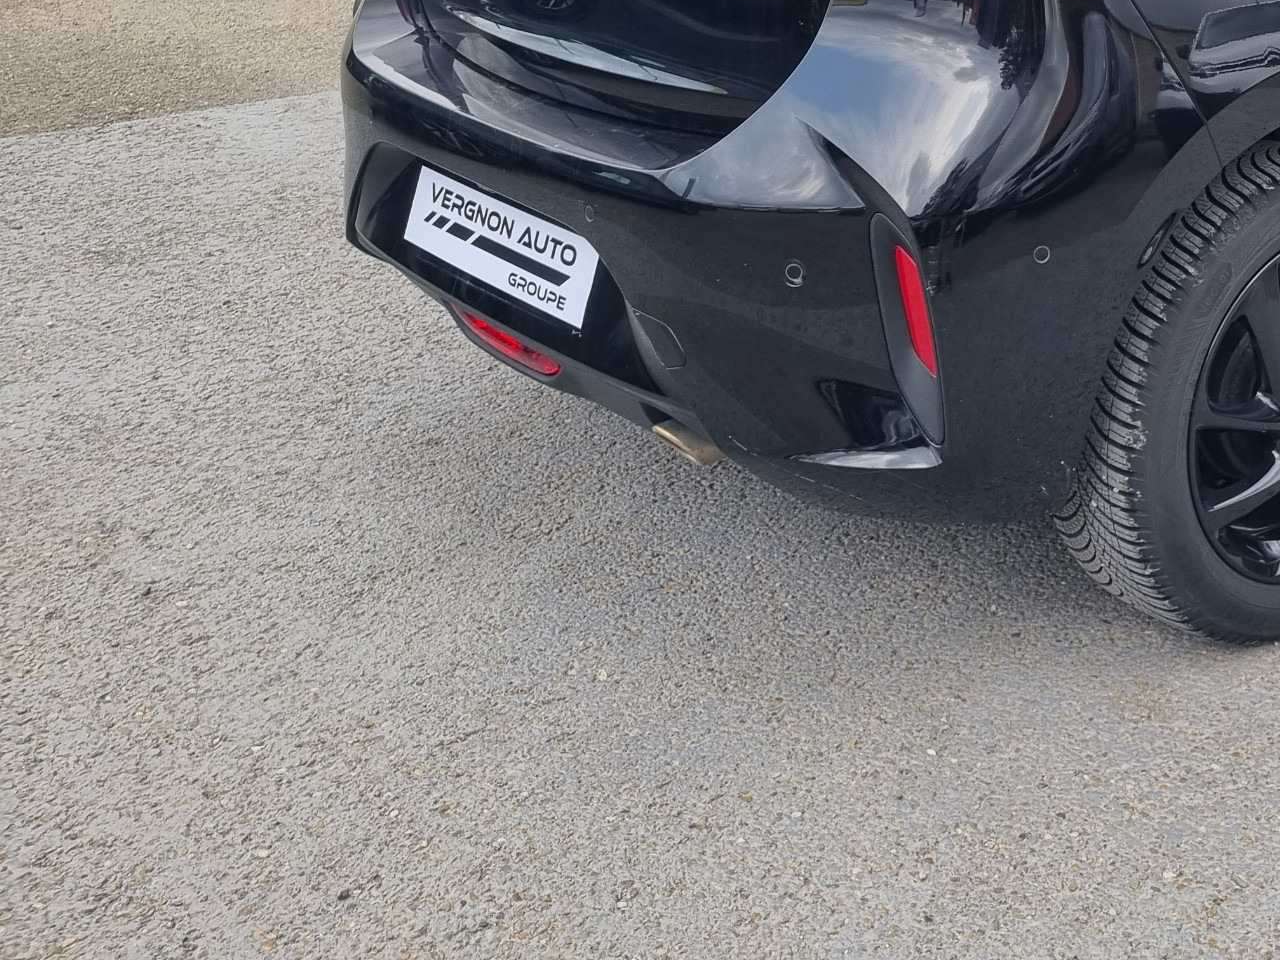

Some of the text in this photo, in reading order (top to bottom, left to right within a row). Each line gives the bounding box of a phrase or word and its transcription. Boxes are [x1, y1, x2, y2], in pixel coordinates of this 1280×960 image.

[432, 182, 577, 266] VERGNON AUTO
[508, 272, 567, 311] GROUPE
